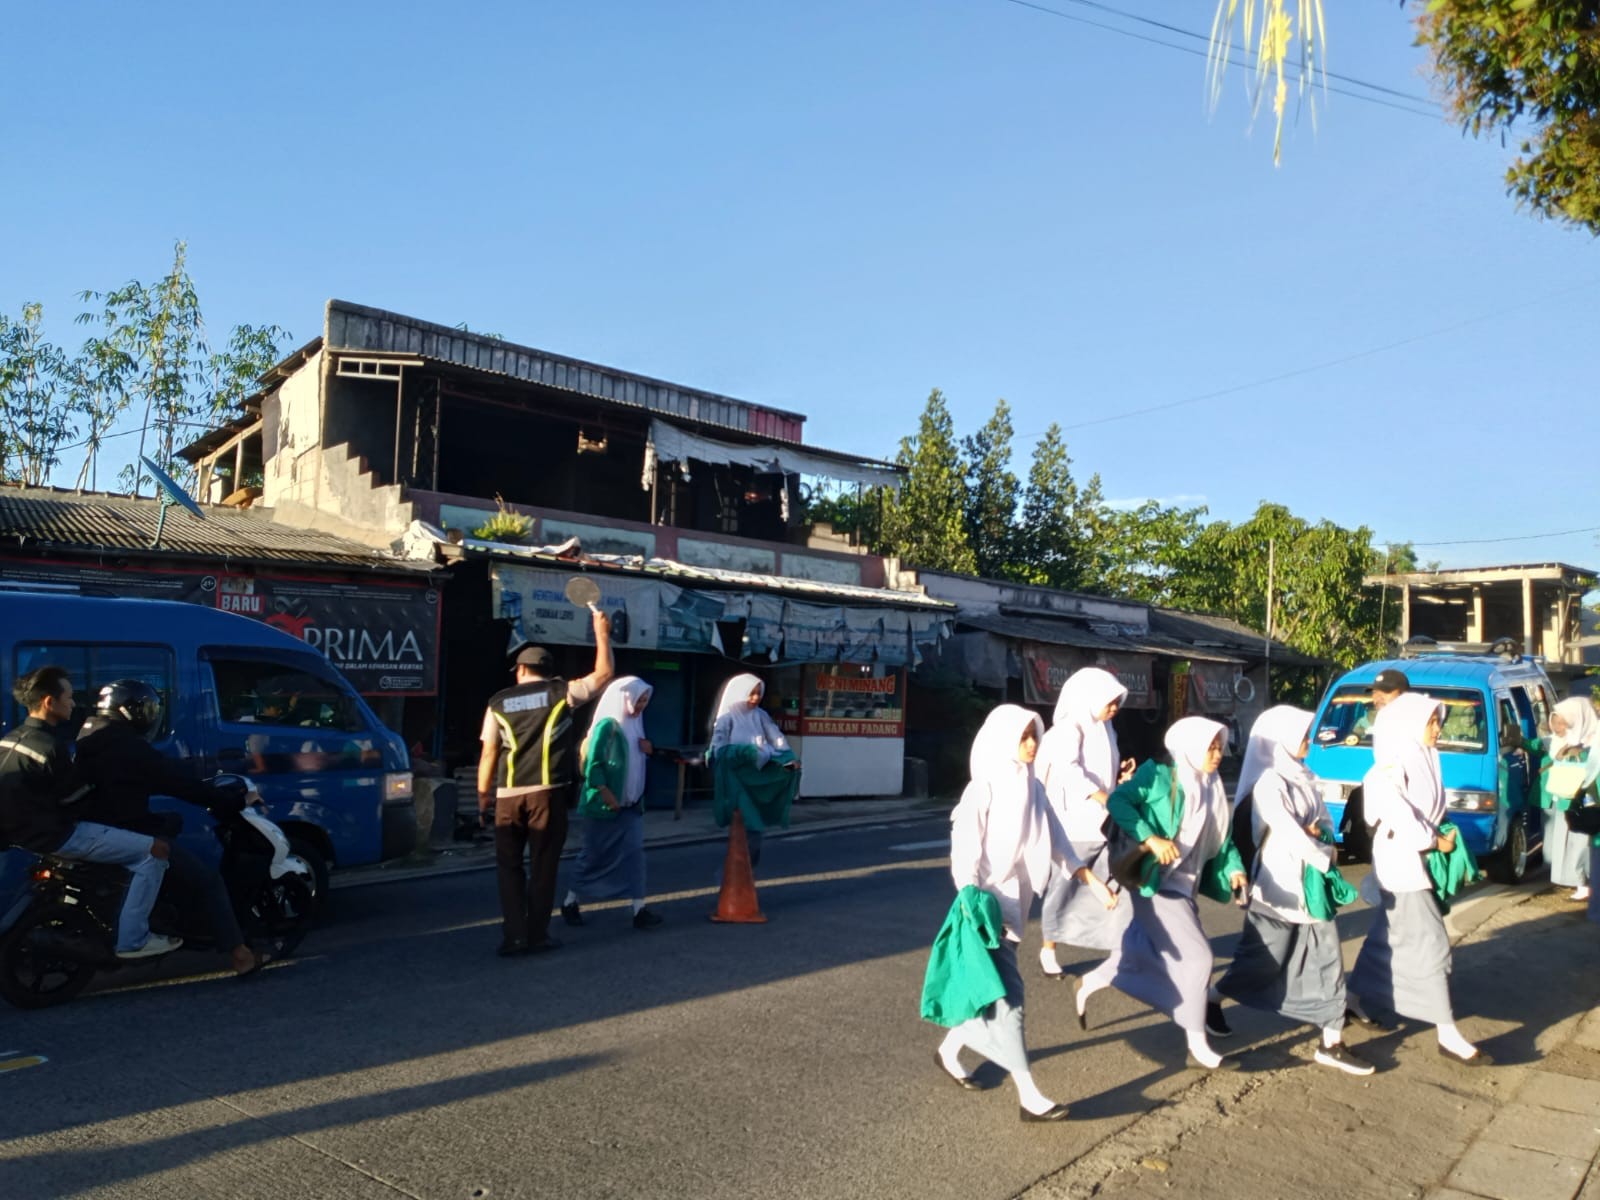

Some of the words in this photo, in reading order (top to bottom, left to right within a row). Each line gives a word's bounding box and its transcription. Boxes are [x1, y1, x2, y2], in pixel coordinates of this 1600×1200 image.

[221, 595, 260, 612] BARU
[303, 627, 423, 661] PRIMA
[808, 722, 859, 734] MASAKAN
[861, 723, 897, 735] PADANG
